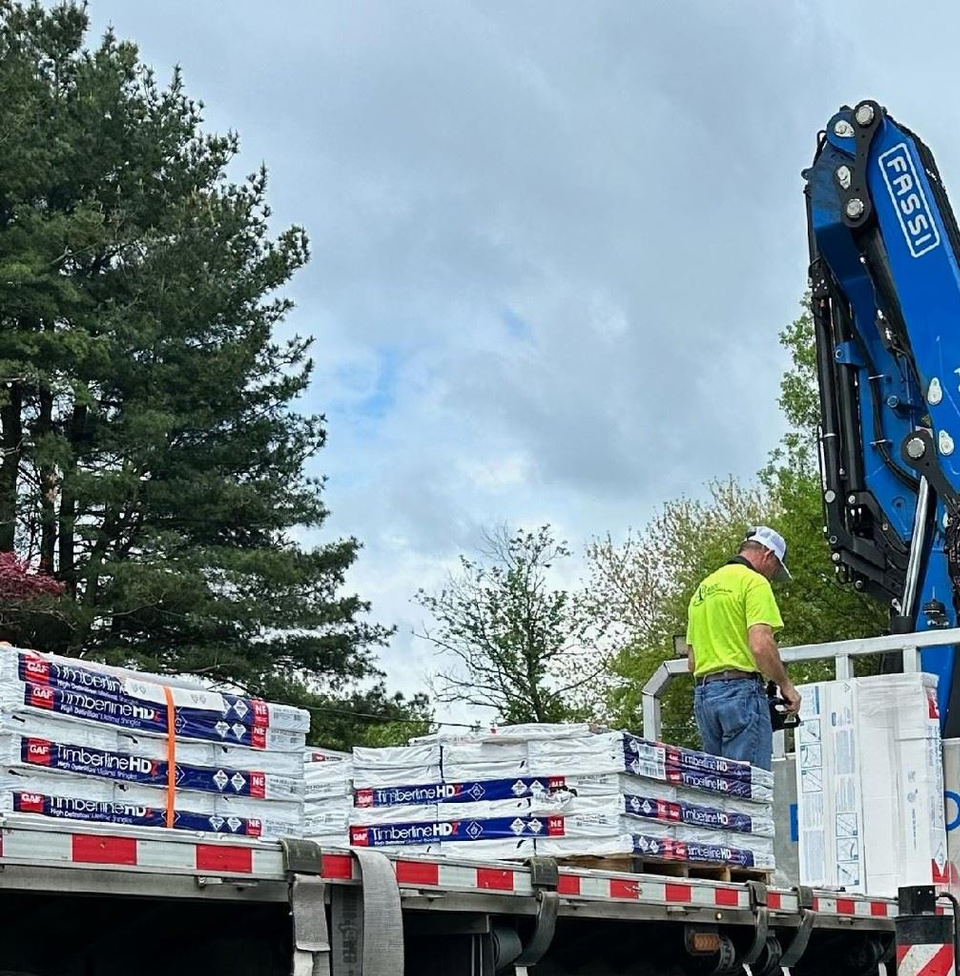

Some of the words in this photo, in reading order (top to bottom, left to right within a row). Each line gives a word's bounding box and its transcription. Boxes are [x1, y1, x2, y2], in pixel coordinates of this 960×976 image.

[886, 156, 932, 246] FASSI
[27, 662, 48, 674] GAF
[33, 687, 53, 699] GAF
[255, 704, 268, 716] NE
[29, 744, 49, 755] GAF
[252, 776, 264, 787] NE
[22, 793, 43, 804] GAF
